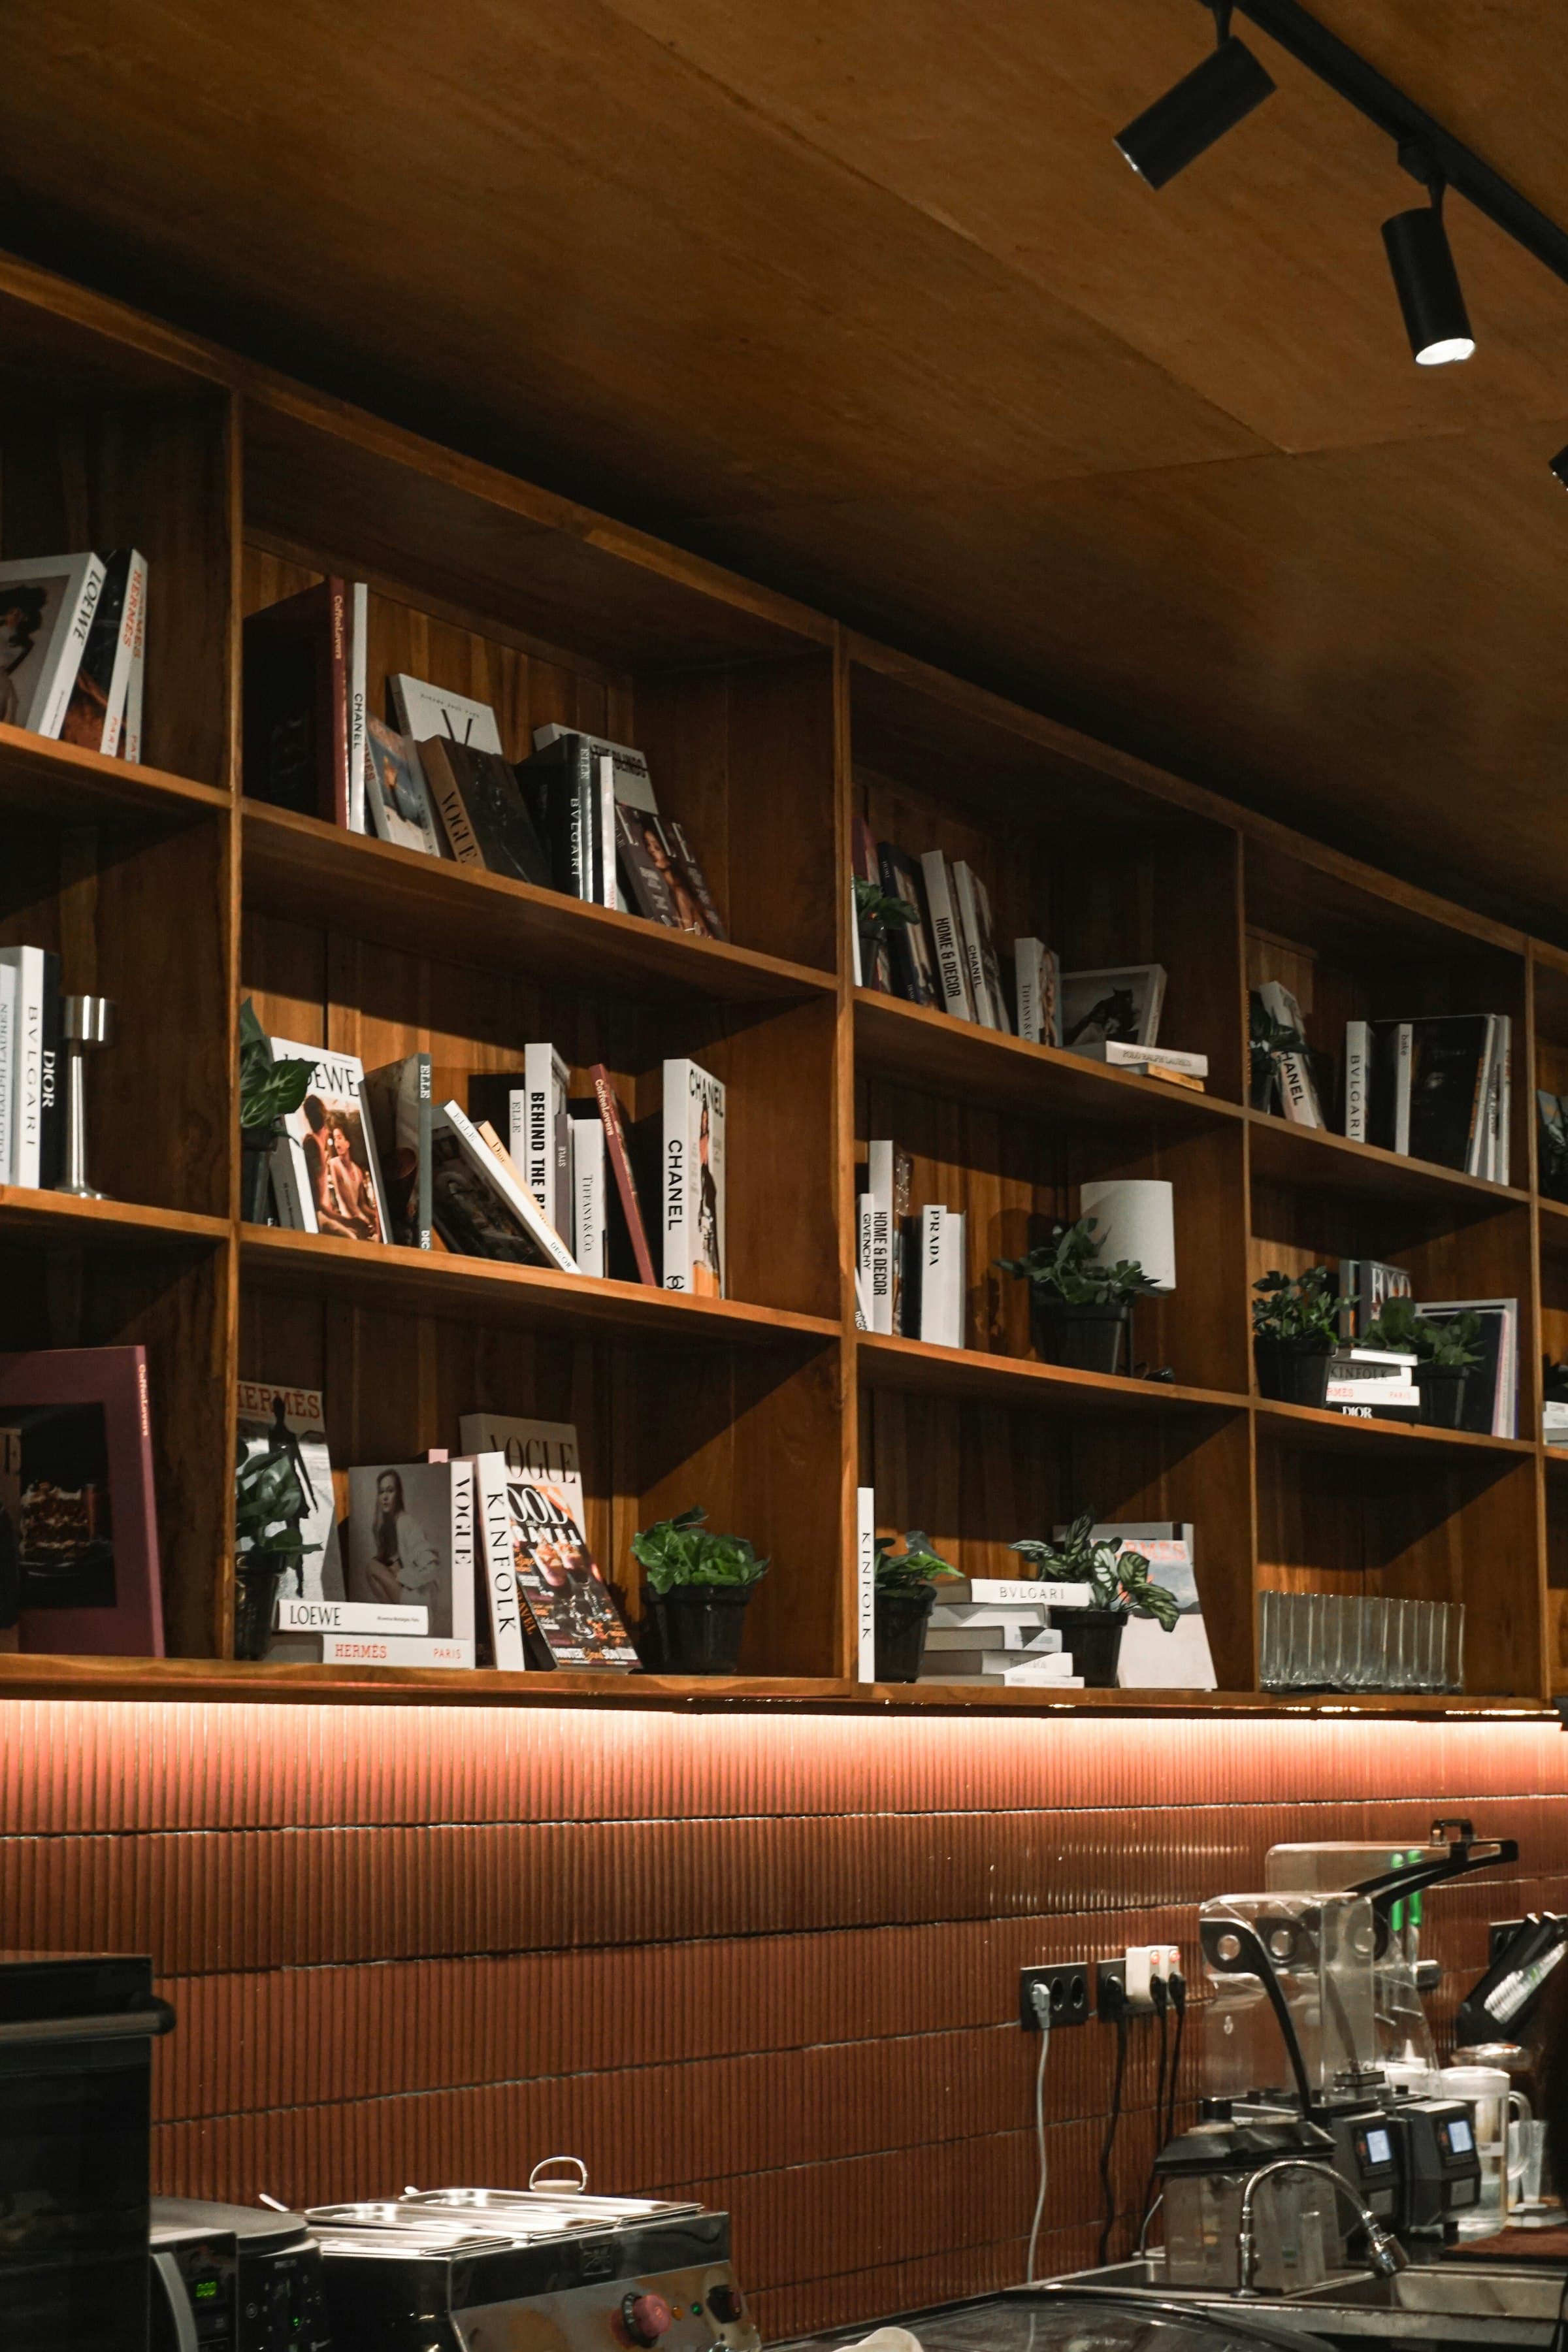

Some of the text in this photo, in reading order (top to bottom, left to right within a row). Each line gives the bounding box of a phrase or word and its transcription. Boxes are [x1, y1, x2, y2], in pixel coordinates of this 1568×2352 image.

[73, 570, 100, 647] LOEWE
[353, 693, 364, 750] CHANEL
[580, 748, 591, 779] ELLE
[440, 791, 478, 863] VOGUE
[570, 797, 581, 876] BVLGARI
[936, 917, 953, 949] HOME
[943, 963, 961, 998] DECOR
[969, 945, 981, 988] CHANEL
[26, 1007, 38, 1145] BVLGARI
[42, 1050, 56, 1109] DIOR
[420, 1064, 431, 1099] ELLE
[689, 1068, 724, 1119] CHANEL
[1281, 1050, 1304, 1107] HANEL
[1350, 1054, 1360, 1137] BVLGARI
[512, 1102, 521, 1133] ELLE
[531, 1092, 545, 1151] BEHIND
[595, 1078, 615, 1136] CoffeeLovers
[531, 1158, 545, 1186] THE
[558, 1145, 567, 1168] STYLE
[668, 1139, 683, 1231] CHANEL
[862, 1213, 871, 1269] GIVENCHY
[874, 1211, 887, 1244] HOME
[929, 1210, 939, 1267] PRADA
[551, 1241, 572, 1269] DECOR
[874, 1258, 887, 1296] DECOR
[1342, 1405, 1373, 1418] DIOR
[454, 1477, 471, 1565] VOGUE
[487, 1492, 518, 1634] KINFOLK
[862, 1532, 871, 1639] KINFOLK
[290, 1605, 341, 1626] LOEWE
[1000, 1586, 1064, 1599] BVLGARI
[433, 1648, 461, 1659] PARIS
